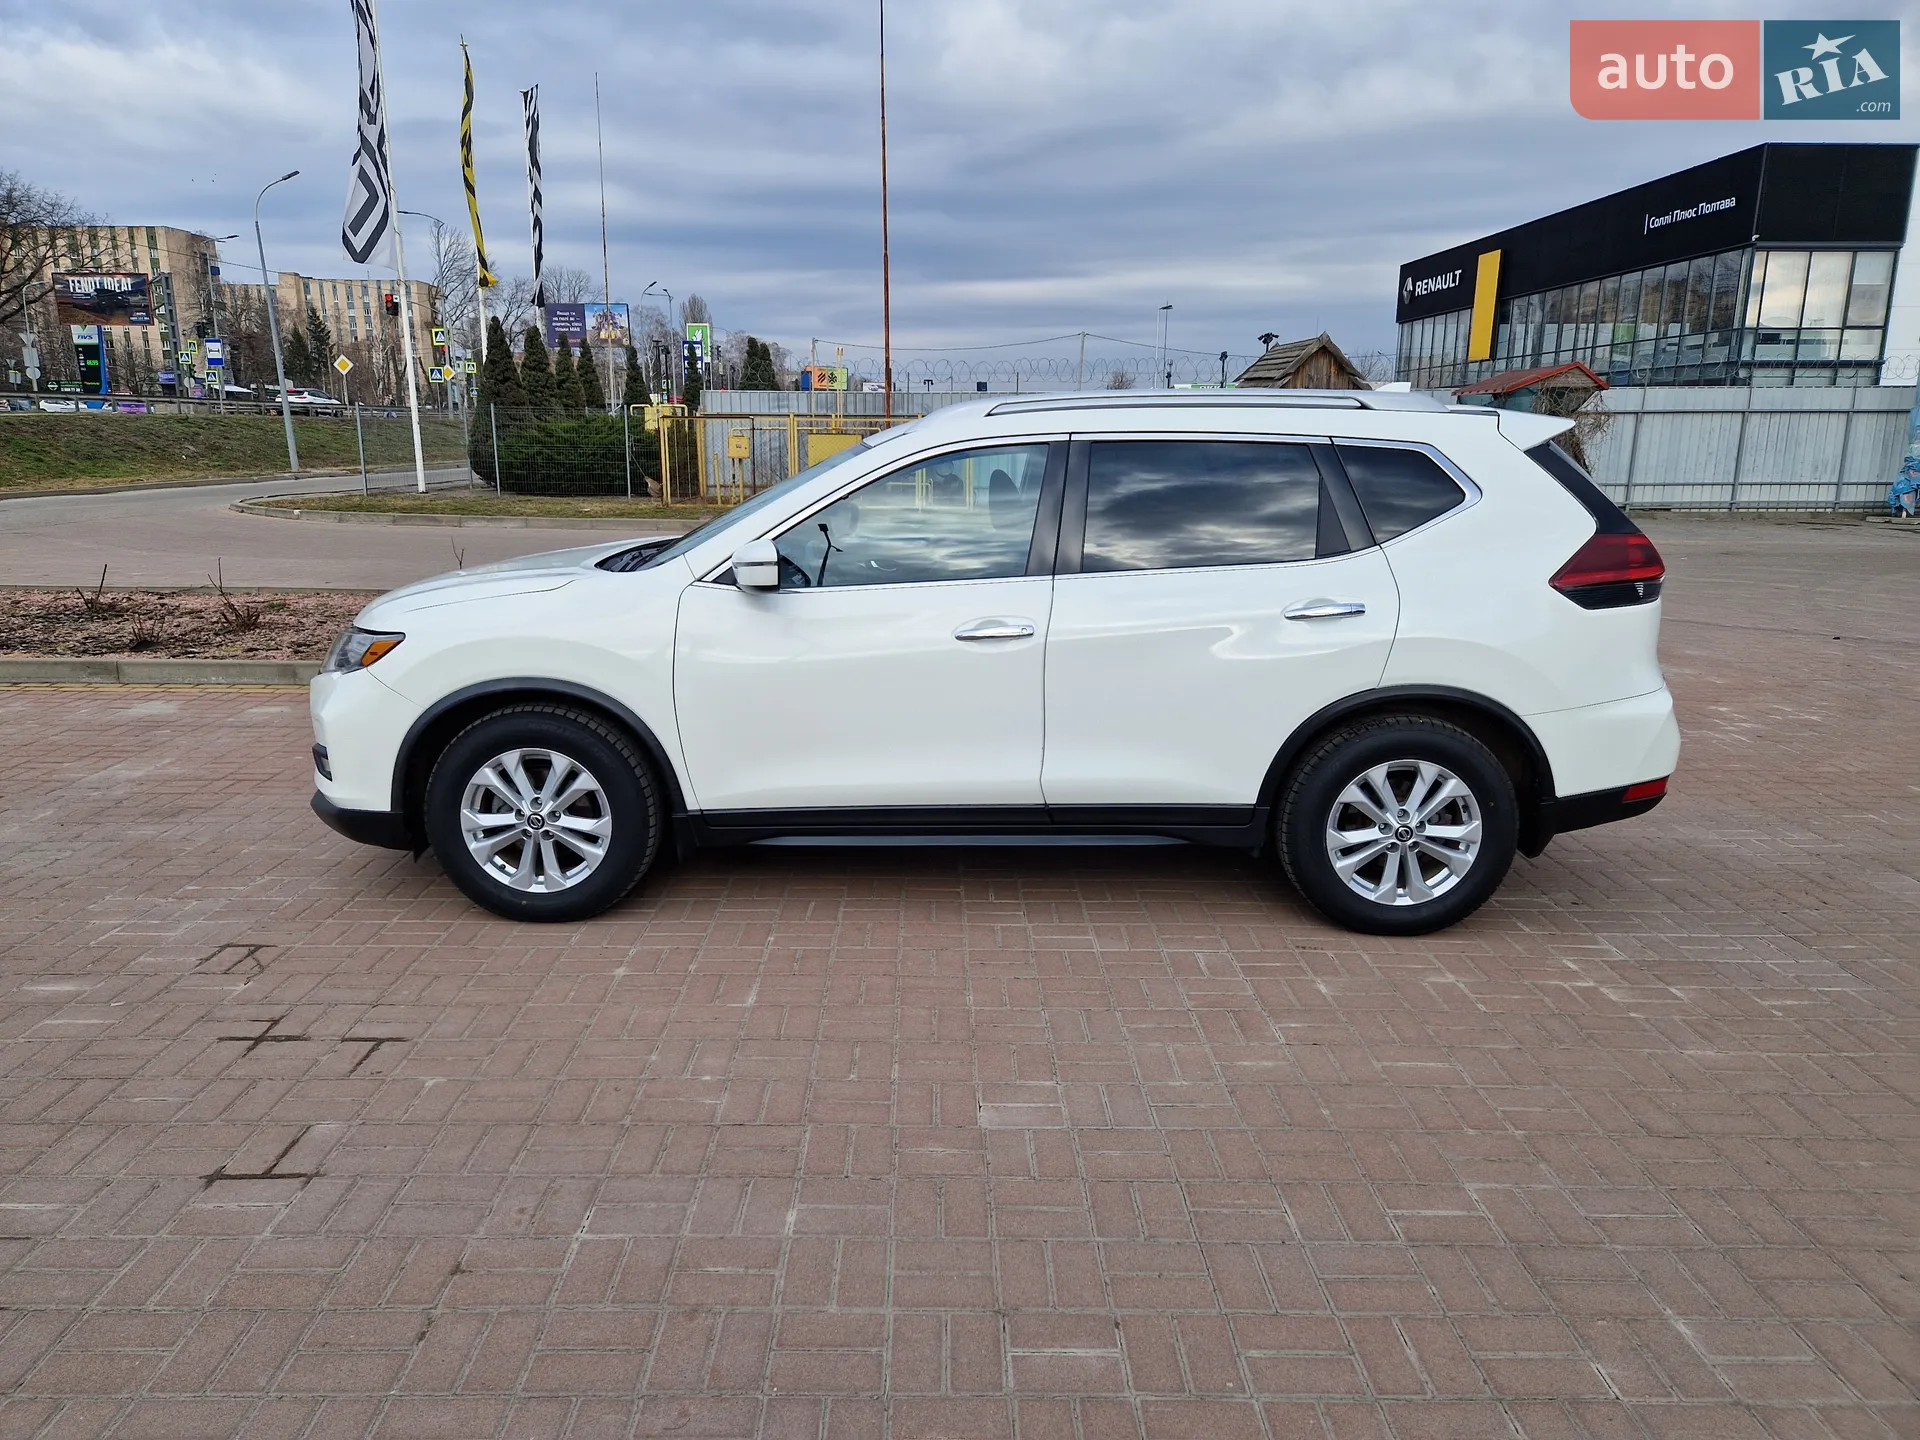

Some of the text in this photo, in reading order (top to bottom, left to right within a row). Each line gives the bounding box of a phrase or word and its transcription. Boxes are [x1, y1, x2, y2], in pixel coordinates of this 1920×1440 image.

[1649, 196, 1736, 229] Соллі Плюс Полтава
[69, 277, 101, 293] FENDT
[1415, 269, 1462, 297] RENAULT
